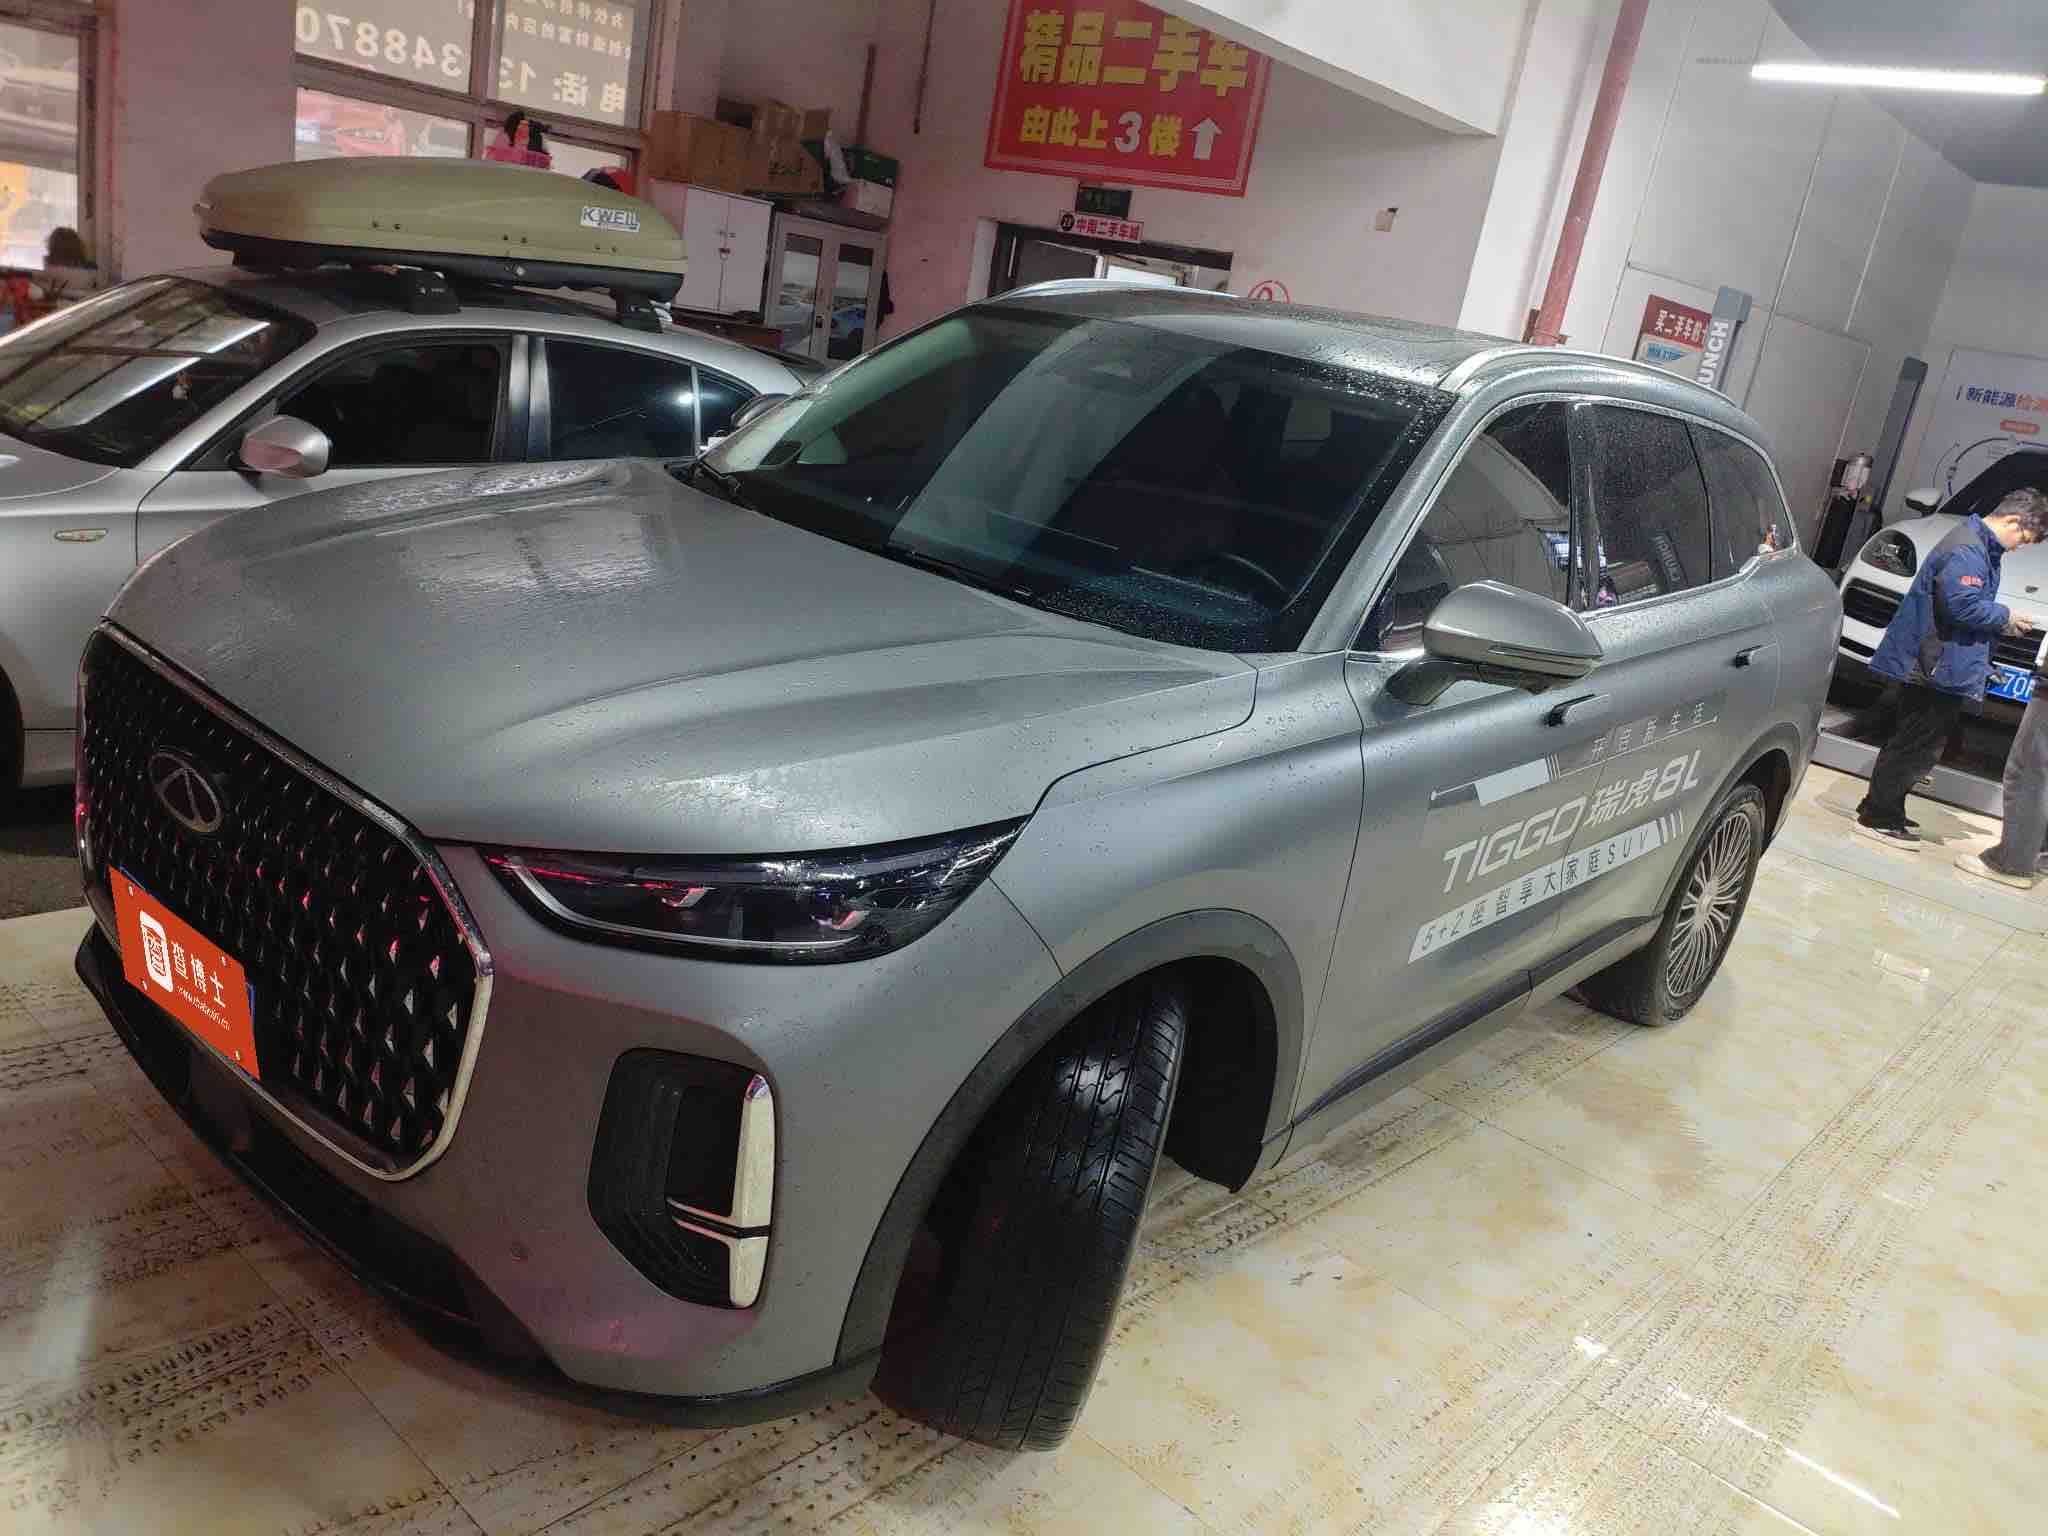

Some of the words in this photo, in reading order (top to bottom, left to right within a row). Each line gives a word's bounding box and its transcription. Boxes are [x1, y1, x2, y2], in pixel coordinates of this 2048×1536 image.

[1018, 8, 1249, 97] 精品二手车
[1019, 104, 1184, 158] 由此上3楼
[1443, 795, 1588, 893] TIGGO
